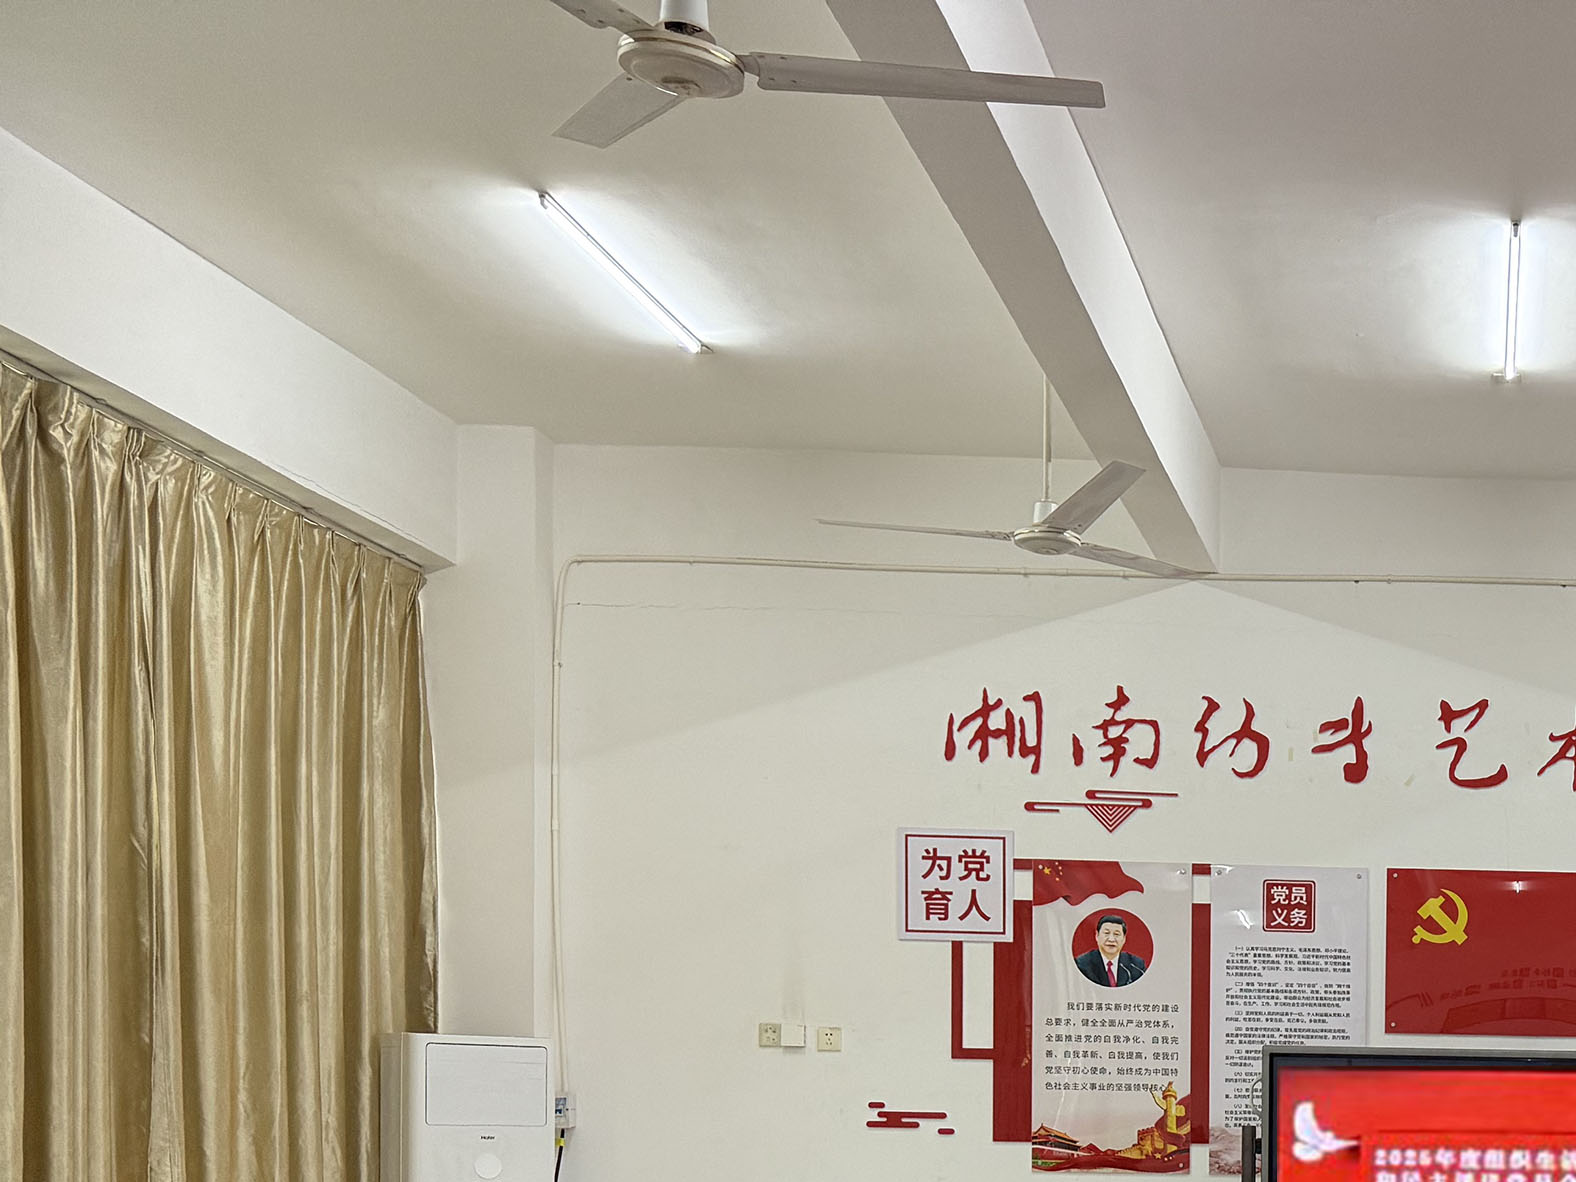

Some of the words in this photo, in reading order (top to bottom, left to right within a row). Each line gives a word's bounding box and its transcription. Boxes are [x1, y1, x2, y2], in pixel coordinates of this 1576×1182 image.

[1067, 1002, 1179, 1013] 我们要落实新时代党的建设
